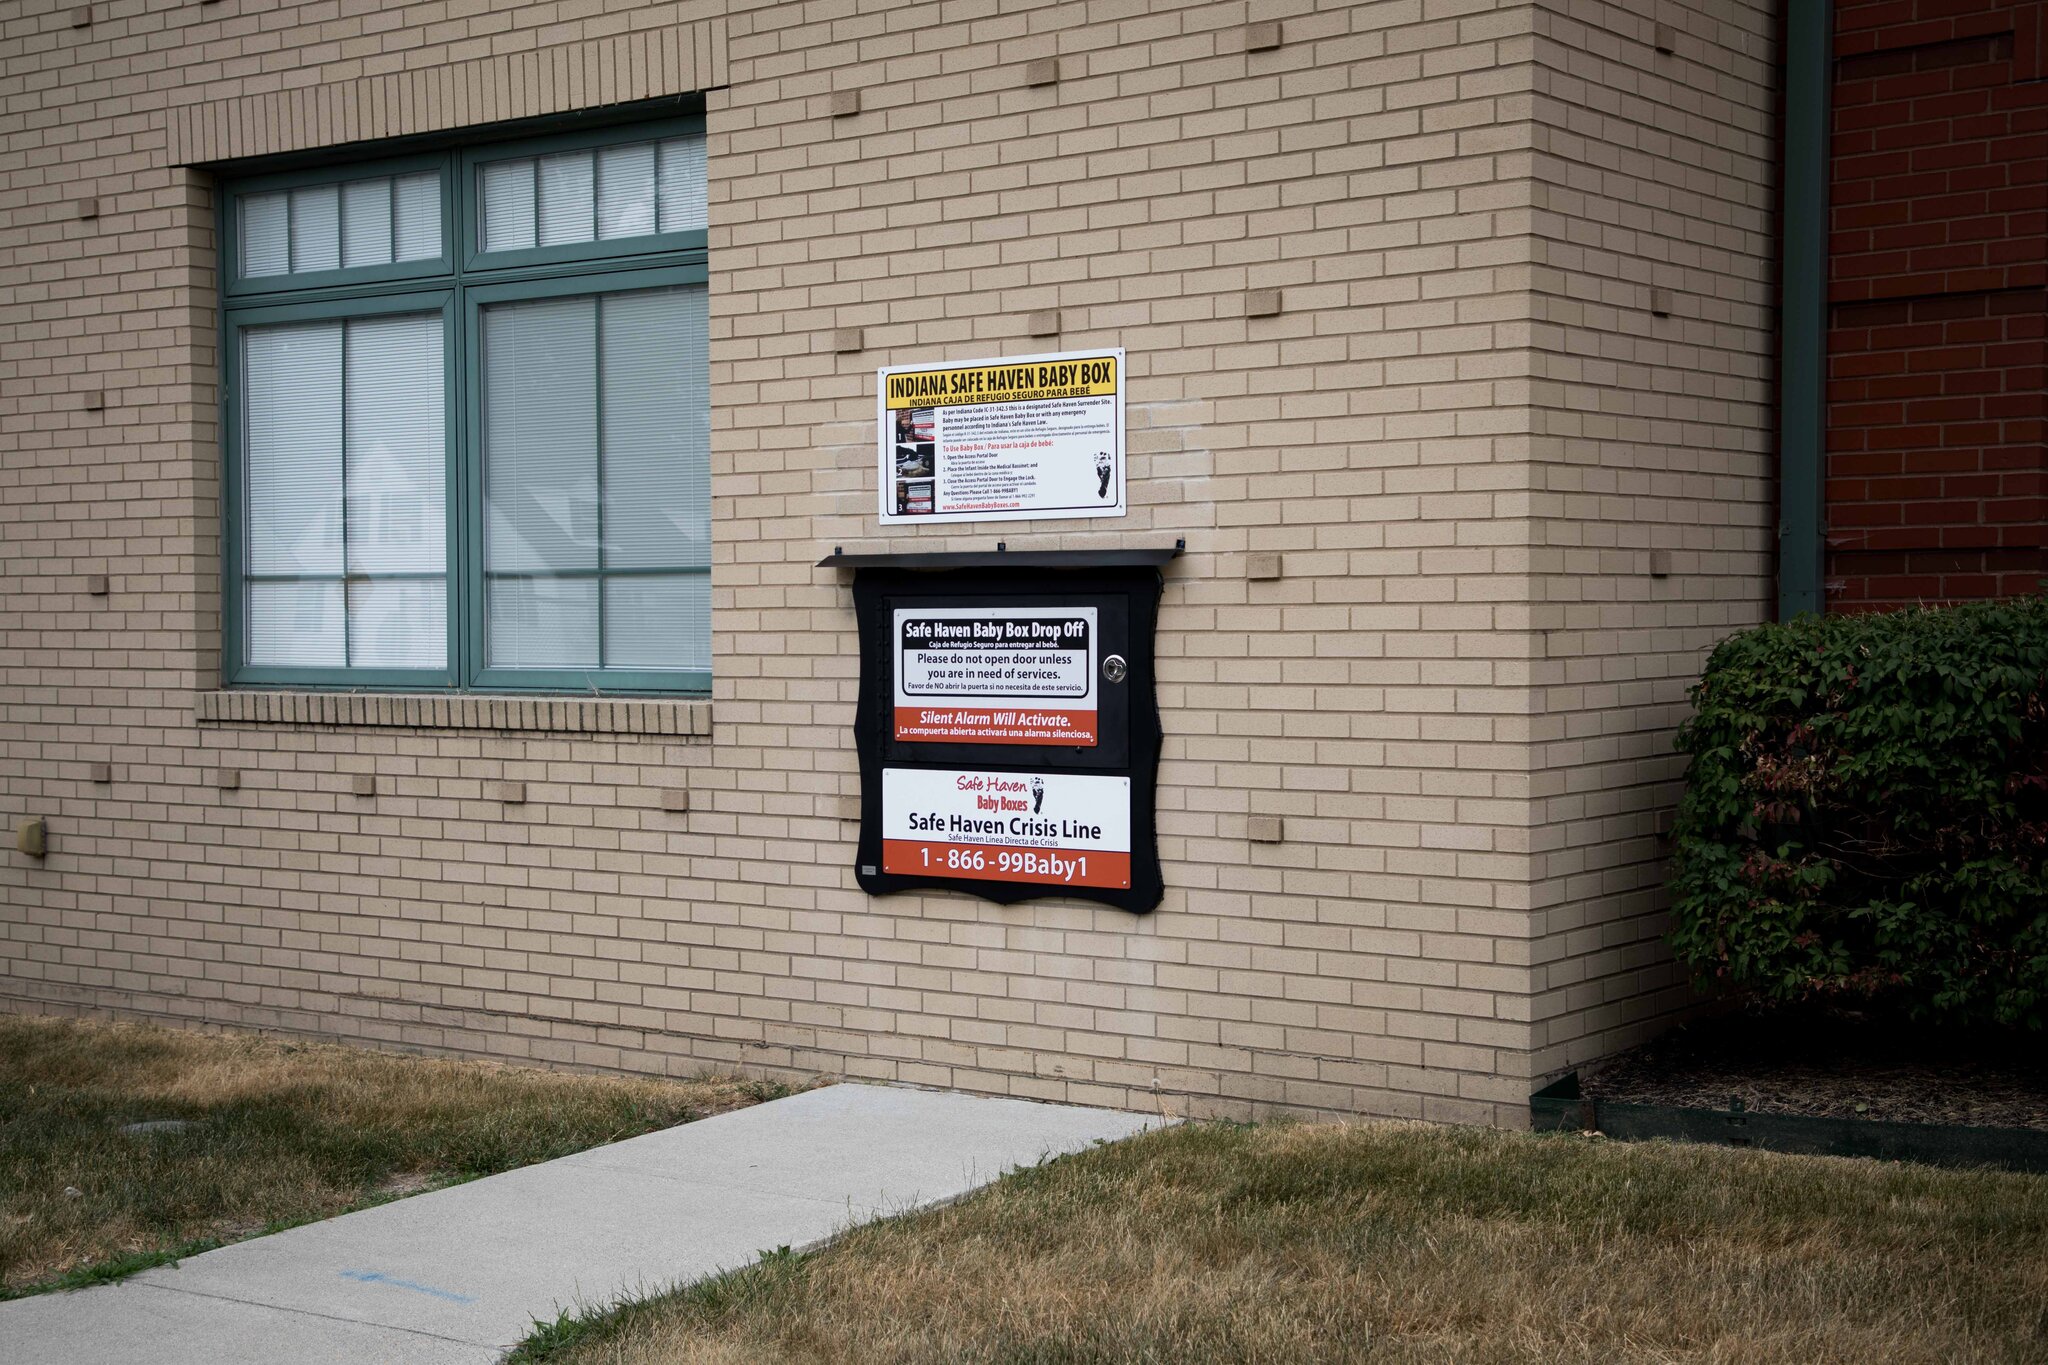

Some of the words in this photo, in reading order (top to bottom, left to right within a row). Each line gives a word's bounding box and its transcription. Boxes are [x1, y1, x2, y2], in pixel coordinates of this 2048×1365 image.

[890, 375, 947, 398] INDIANA
[951, 372, 983, 394] SAFE
[988, 368, 1034, 390] HAVEN
[1039, 364, 1077, 387] BABY
[1082, 362, 1110, 384] BOX
[910, 398, 941, 406] INDIANA
[944, 396, 962, 404] CAJA
[977, 392, 1010, 401] REFUGIO
[1012, 390, 1044, 399] SEGURO
[1047, 388, 1067, 397] PARA
[1070, 385, 1090, 395] BEBÉ
[960, 444, 973, 452] Baby
[1019, 441, 1029, 449] caja
[898, 468, 902, 476] 2
[943, 502, 1020, 510] www.SafeHavenBabyBoxes.com
[906, 622, 931, 637] Safe
[934, 622, 970, 637] Haven
[974, 622, 1003, 641] Baby
[1006, 622, 1029, 637] Box
[1032, 622, 1061, 640] Drop
[1064, 621, 1084, 637] Off
[929, 641, 941, 649] Caja
[950, 641, 972, 649] Refugio
[918, 653, 948, 663] Please
[951, 653, 963, 663] do
[966, 655, 982, 664] not
[984, 656, 1010, 666] open
[1013, 653, 1036, 664] door
[1039, 654, 1072, 664] unless
[928, 670, 945, 680] you
[948, 670, 963, 678] are
[966, 669, 974, 678] in
[978, 668, 1002, 678] need
[1005, 668, 1015, 678] of
[1017, 669, 1060, 679] services.
[920, 711, 953, 724] Silent
[954, 712, 990, 724] Alarm
[993, 712, 1016, 725] Will
[1017, 713, 1071, 727] Activate.
[900, 726, 908, 734] La
[910, 727, 948, 736] compuerta
[950, 727, 976, 736] abierta
[977, 728, 1007, 736] activará
[1025, 729, 1050, 737] alarma
[1052, 730, 1093, 739] silenciosa.
[957, 775, 983, 791] Safe
[986, 777, 1027, 792] Haven
[977, 795, 999, 813] Baby
[1000, 796, 1028, 811] Boxes
[909, 812, 945, 831] Safe
[950, 814, 1004, 834] Haven
[1010, 817, 1057, 837] Crisis
[1063, 820, 1101, 840] Line
[948, 833, 962, 842] Safe
[964, 834, 984, 842] Haven
[1005, 837, 1028, 845] Directa
[1030, 838, 1039, 846] de
[1040, 838, 1058, 846] Crisis
